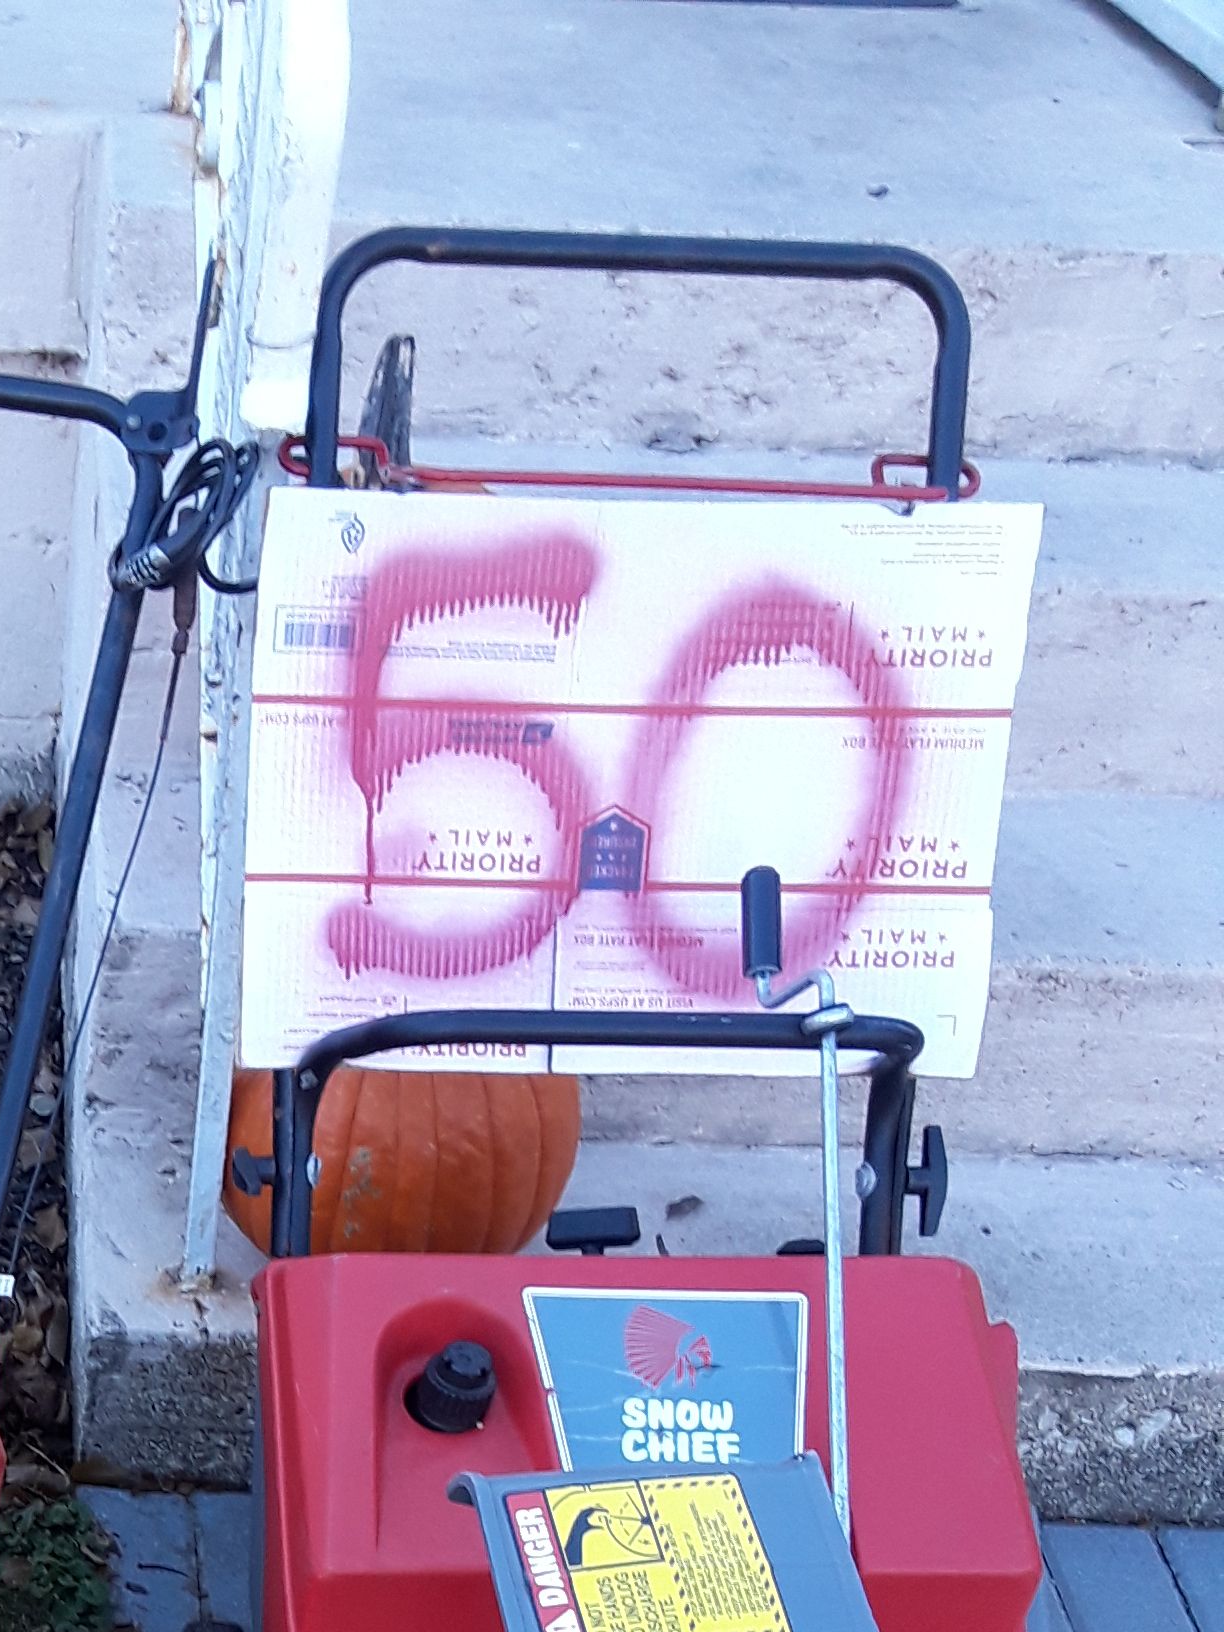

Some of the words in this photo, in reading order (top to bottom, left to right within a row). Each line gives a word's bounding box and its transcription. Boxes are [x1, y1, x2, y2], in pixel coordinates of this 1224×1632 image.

[901, 626, 968, 643] MAIL
[866, 648, 993, 668] PRIORITY
[326, 528, 911, 1001] 50
[448, 829, 513, 847] MAIL
[418, 851, 542, 873] PRIORITY
[861, 928, 927, 946] MAIL
[828, 950, 956, 970] PRIORITY
[621, 1397, 734, 1432] SNOW
[620, 1430, 741, 1464] CHIEF
[515, 1507, 569, 1607] DANGER
[583, 1600, 606, 1629] NOT
